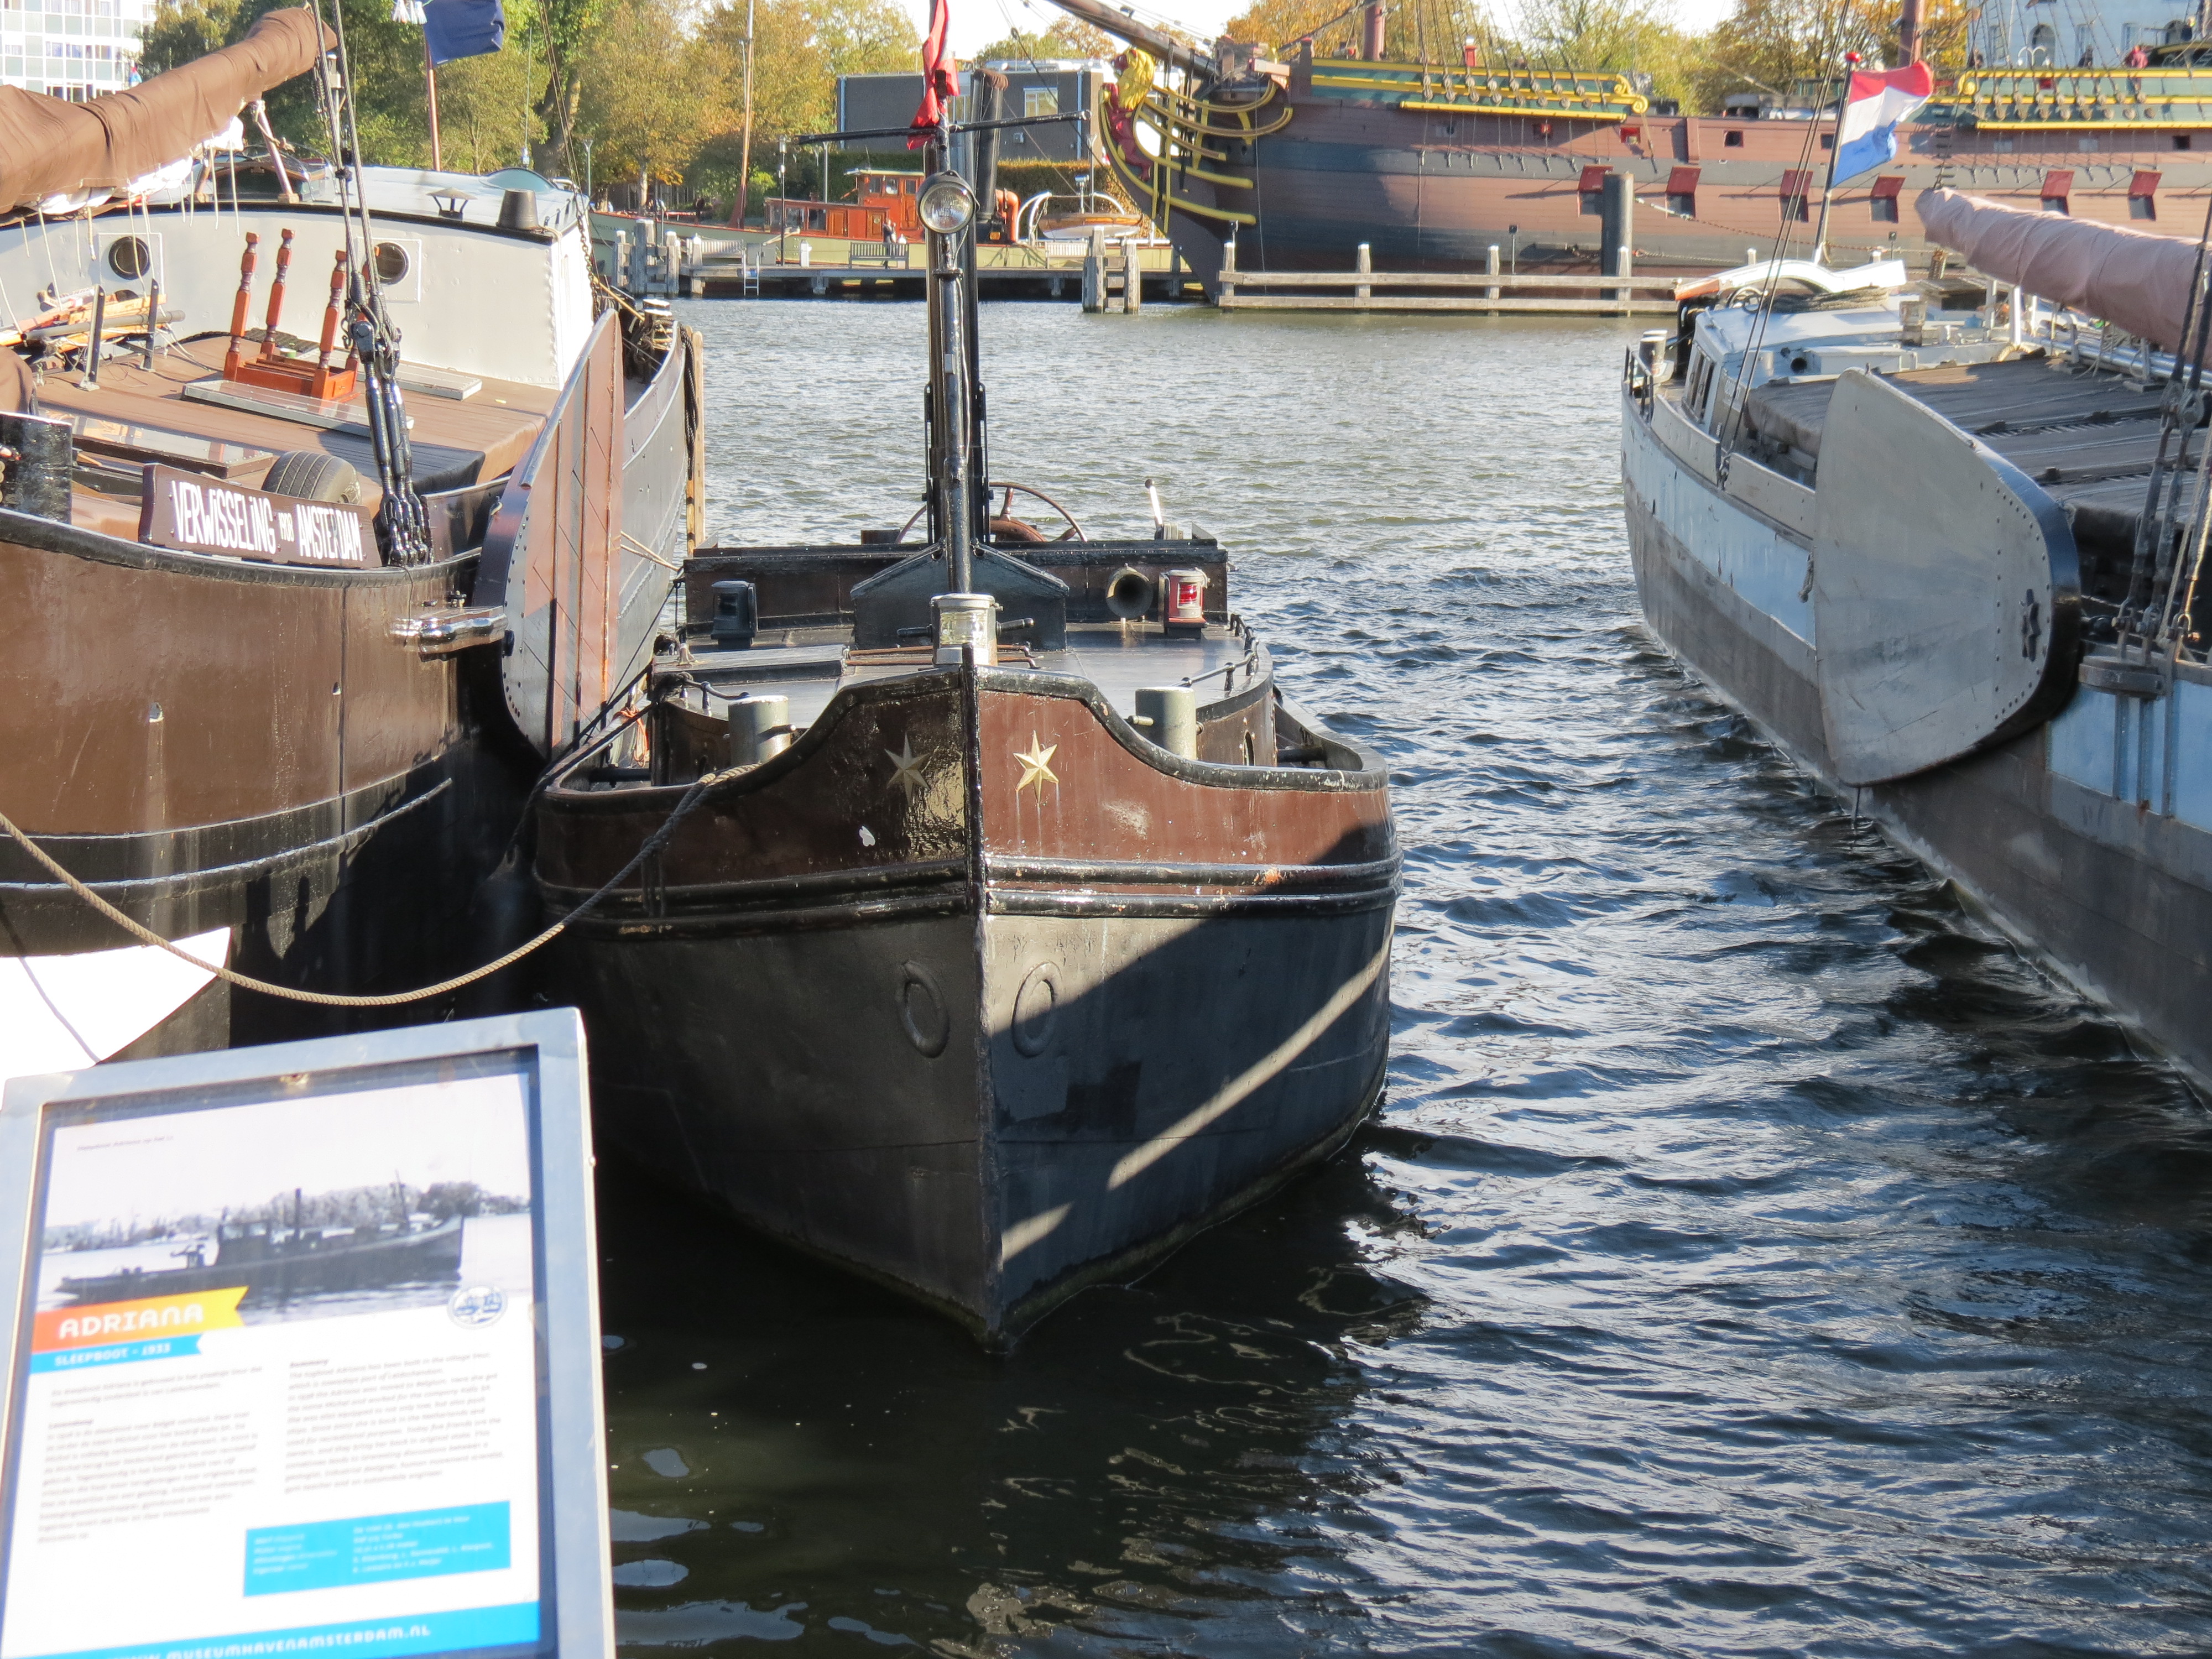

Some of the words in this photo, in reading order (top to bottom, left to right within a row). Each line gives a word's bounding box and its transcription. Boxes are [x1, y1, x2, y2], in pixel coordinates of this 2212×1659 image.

[278, 512, 294, 542] 1908
[296, 504, 363, 562] AMSTERDAM
[59, 1303, 204, 1340] ADRIANA
[55, 1348, 129, 1366] SLEEPBOOT
